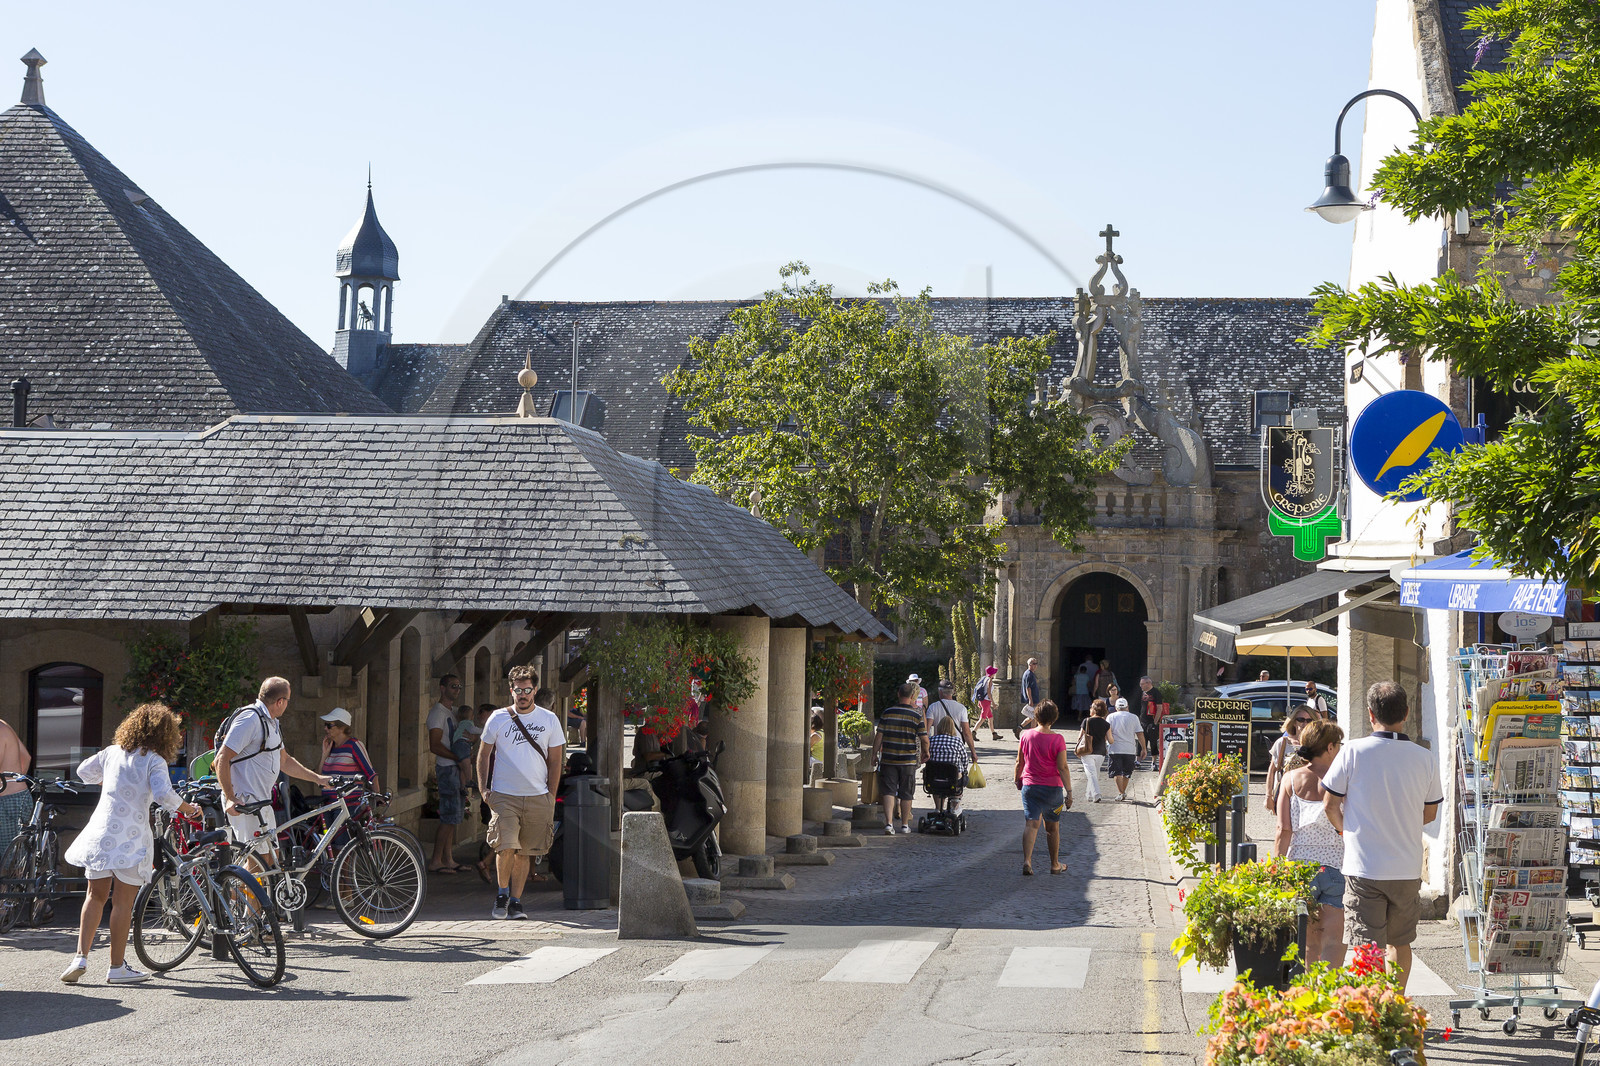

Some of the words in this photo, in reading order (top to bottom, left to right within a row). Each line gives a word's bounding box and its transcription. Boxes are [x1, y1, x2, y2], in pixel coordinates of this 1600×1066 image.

[1273, 492, 1328, 515] CREPERIE
[1401, 582, 1422, 605] PRESSE
[1448, 583, 1481, 610] LIBRAIRIE
[1509, 583, 1563, 613] PAPETERIE
[1197, 699, 1250, 711] CREPERIE
